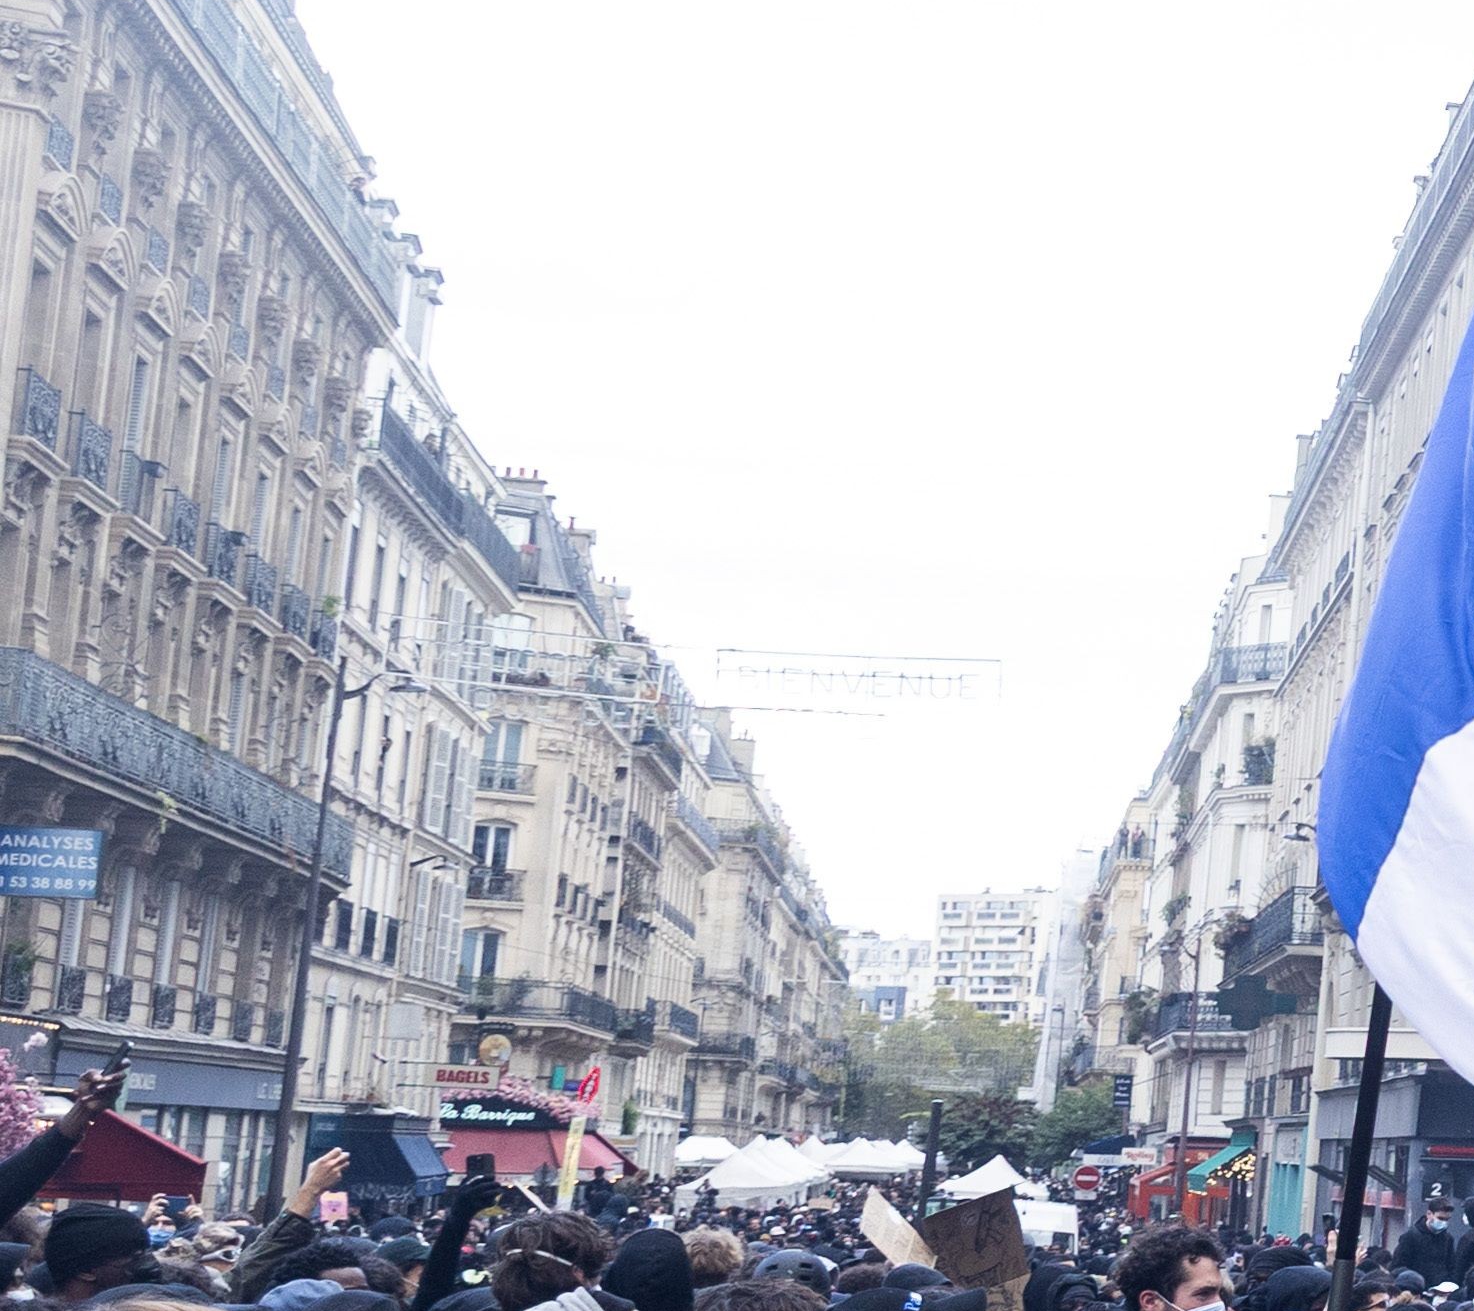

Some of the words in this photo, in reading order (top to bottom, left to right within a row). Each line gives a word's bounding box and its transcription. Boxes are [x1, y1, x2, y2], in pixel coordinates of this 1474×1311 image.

[737, 666, 980, 700] BIENVENUE
[0, 834, 94, 851] ANALYSES
[0, 853, 98, 870] MEDICALES
[9, 876, 28, 888] 53
[31, 877, 50, 889] 38
[54, 878, 74, 890] 88
[78, 879, 97, 890] 99
[436, 1068, 490, 1085] BAGELS
[439, 1102, 460, 1120] La
[461, 1103, 537, 1127] Barrique
[1430, 1182, 1442, 1196] 2
